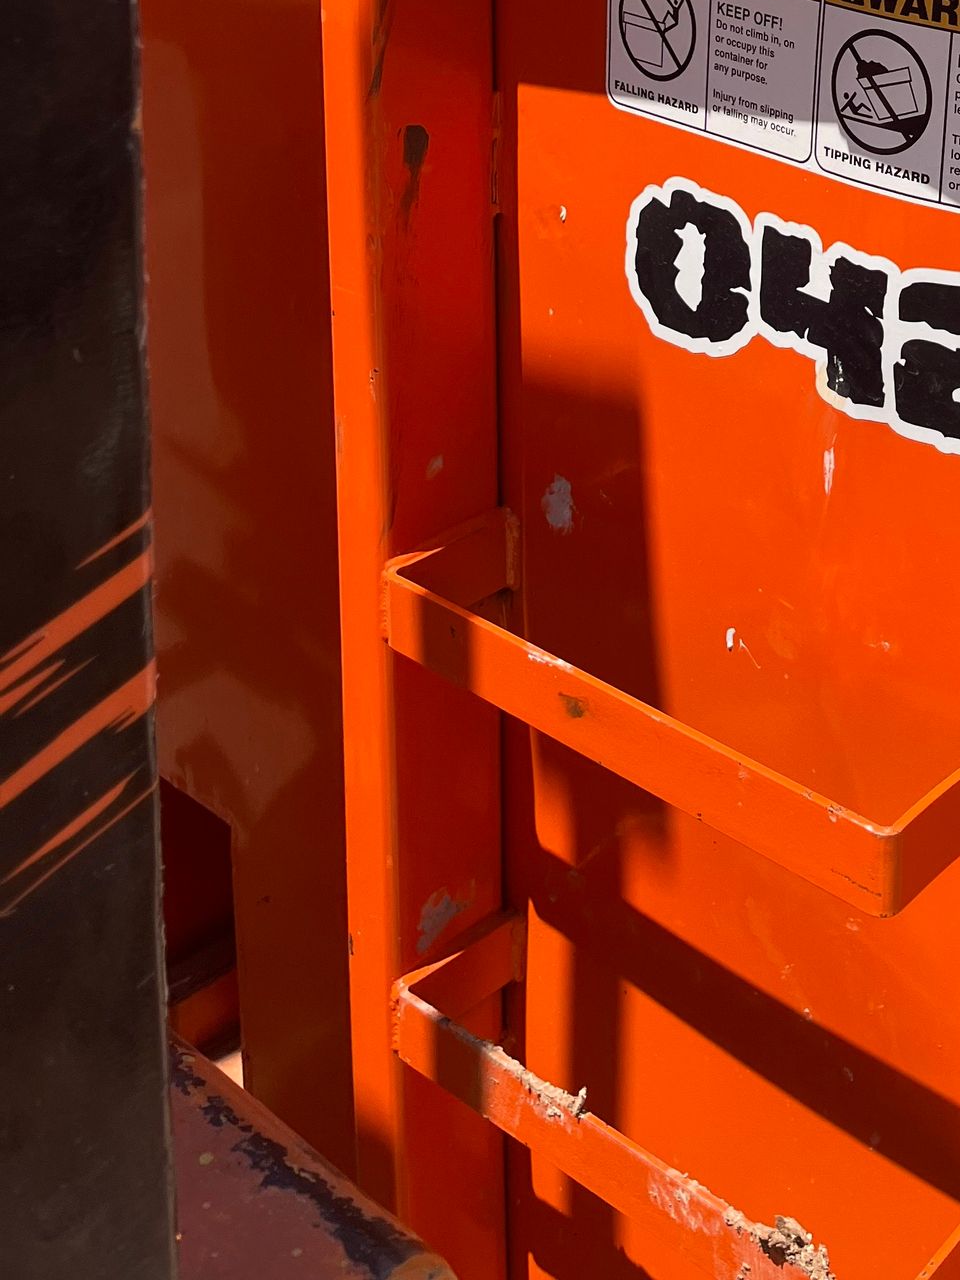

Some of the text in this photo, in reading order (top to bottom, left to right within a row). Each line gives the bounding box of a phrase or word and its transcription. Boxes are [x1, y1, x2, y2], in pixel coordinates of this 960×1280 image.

[717, 1, 783, 31] KEEP OFF!
[715, 35, 775, 58] or occupy this
[716, 19, 795, 49] Do not climb in, on
[714, 63, 768, 85] any purpose.
[715, 49, 768, 70] container for
[614, 79, 699, 115] FALLING HAZARD
[713, 89, 794, 124] Injury from slipping
[712, 104, 797, 137] or falling may occur.
[823, 146, 930, 185] TIPPING HAZARD
[948, 181, 960, 191] or
